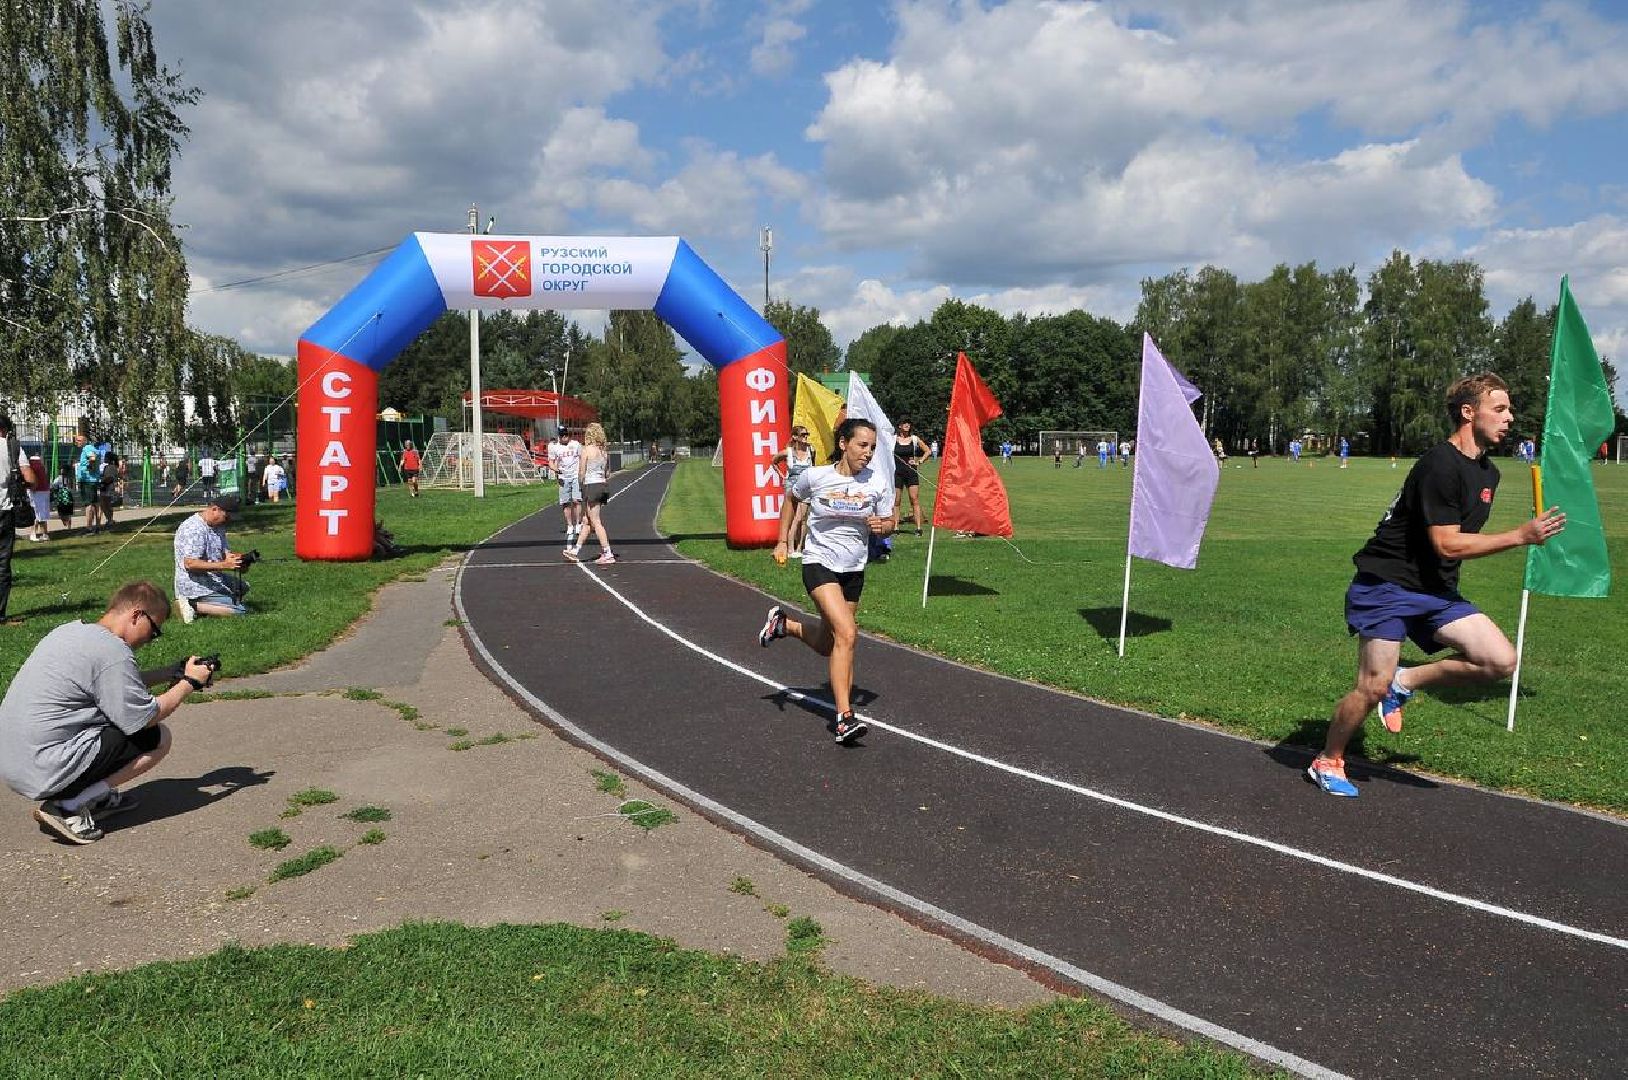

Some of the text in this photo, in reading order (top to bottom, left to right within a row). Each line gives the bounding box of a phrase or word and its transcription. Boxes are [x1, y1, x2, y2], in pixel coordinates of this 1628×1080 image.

[541, 246, 608, 258] РУЗСКИЙ
[542, 261, 633, 277] ГОРОДСКОЙ
[542, 280, 589, 291] ОКРУГ
[745, 367, 785, 521] ФИНИШ
[319, 371, 352, 536] СТАРТ
